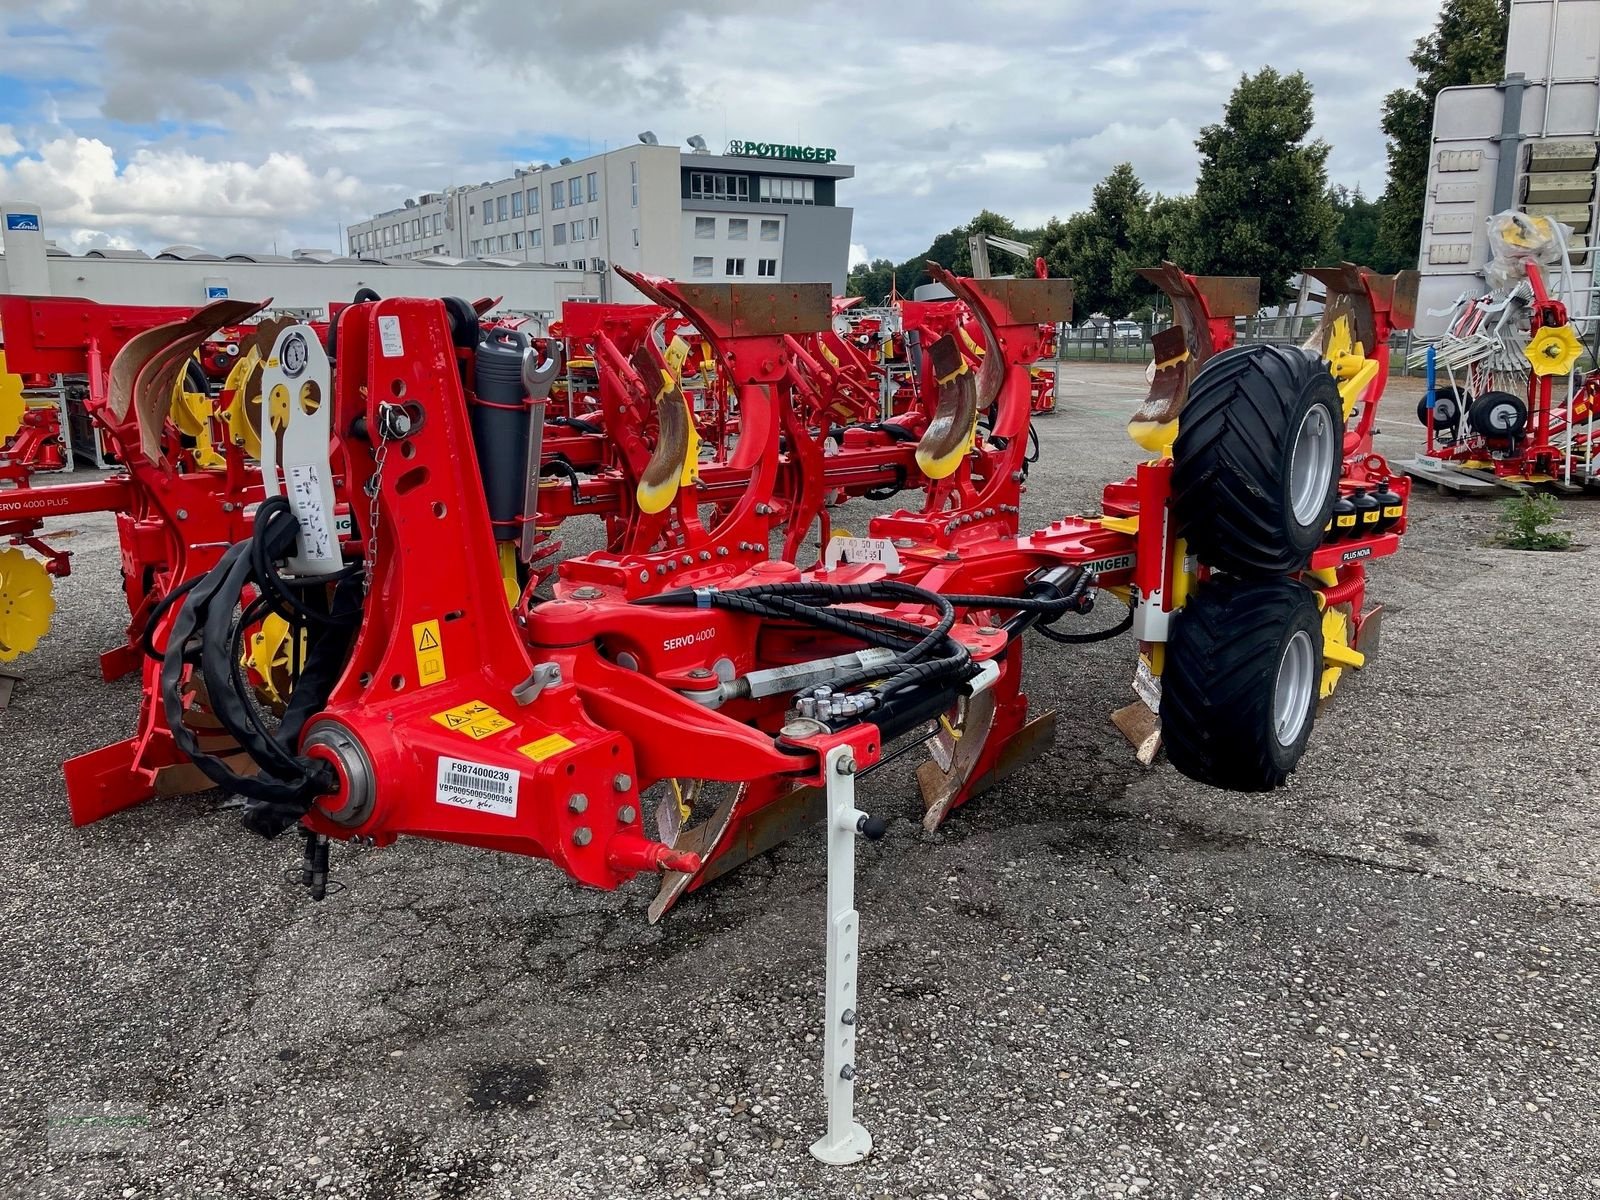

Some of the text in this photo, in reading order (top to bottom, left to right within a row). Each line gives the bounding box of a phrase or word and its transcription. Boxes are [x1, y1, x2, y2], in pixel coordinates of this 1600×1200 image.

[23, 500, 45, 509] 4000
[47, 498, 69, 506] PLUS
[1343, 549, 1370, 560] PLUS NOVA
[663, 628, 715, 650] SERVO 4000
[452, 763, 509, 781] F9874000239
